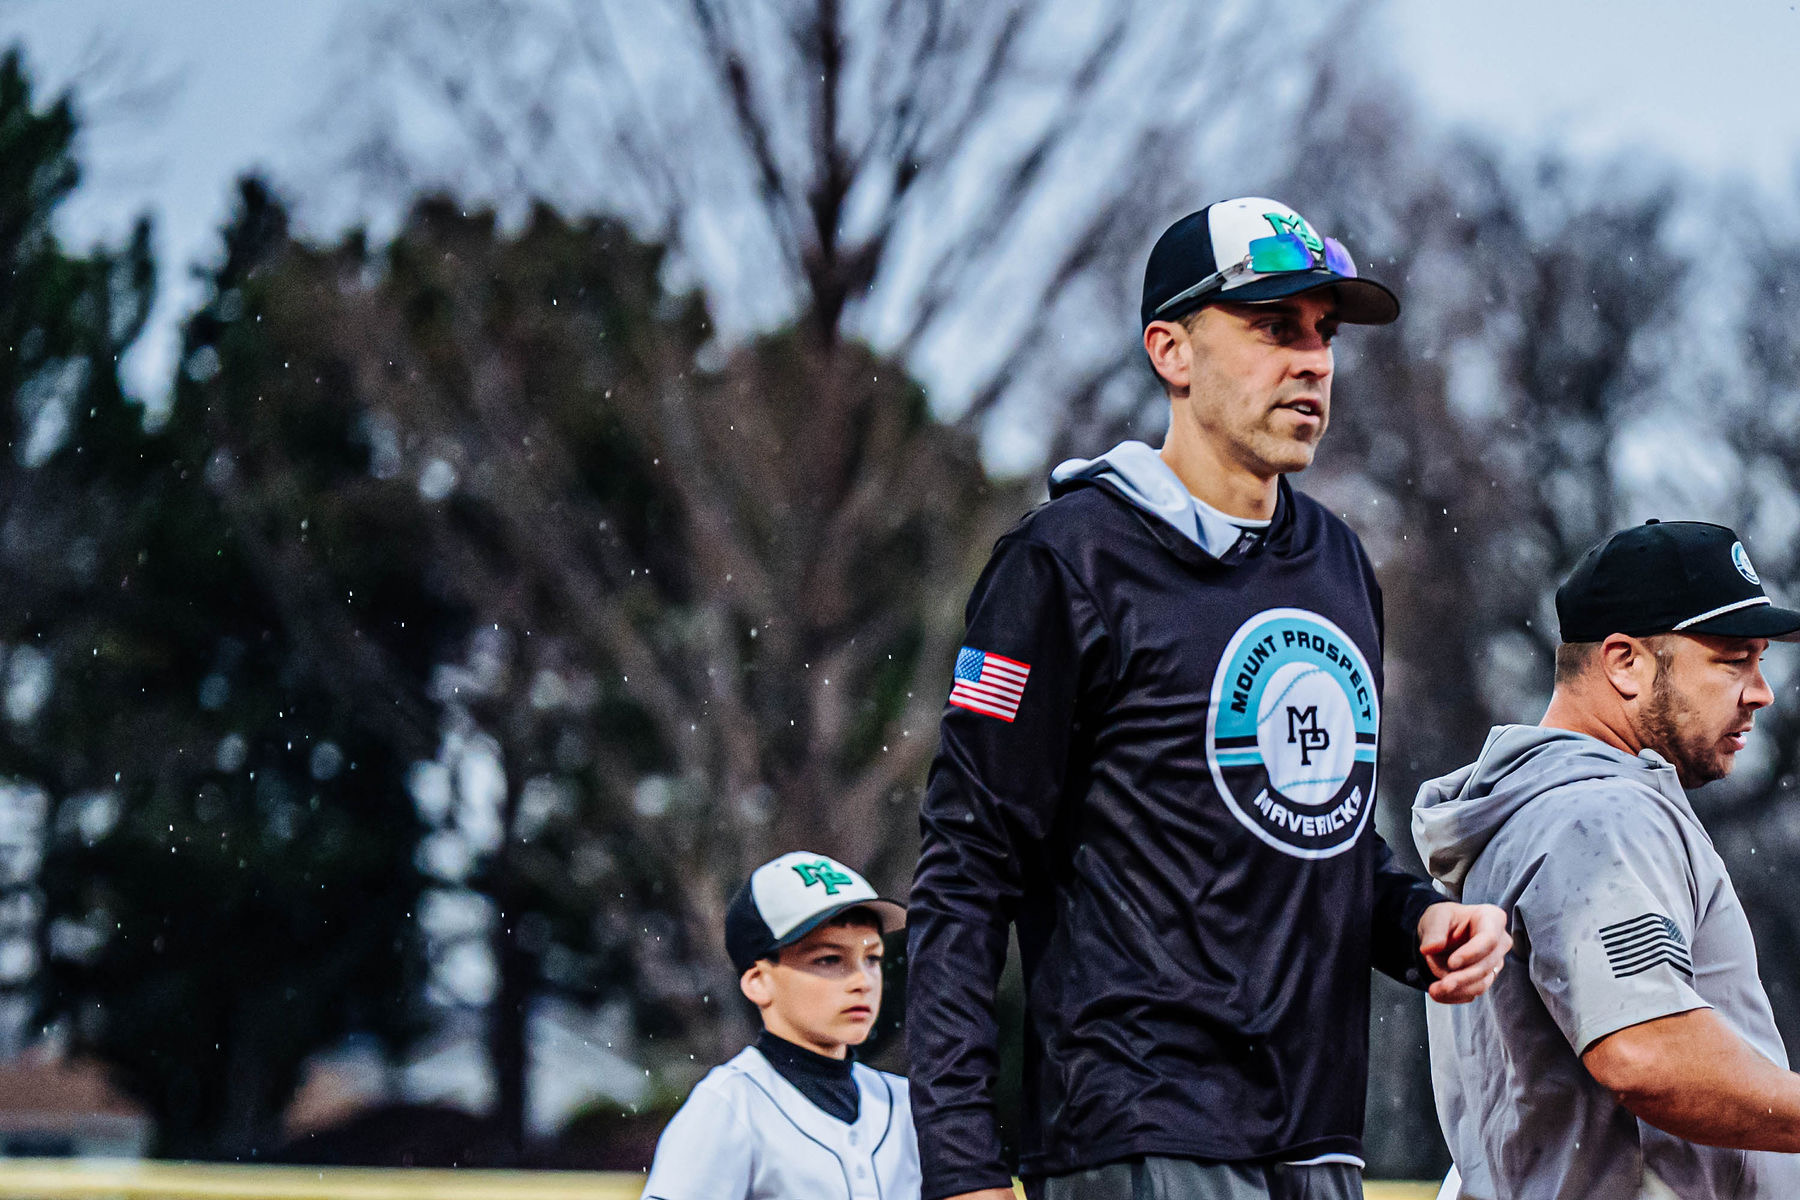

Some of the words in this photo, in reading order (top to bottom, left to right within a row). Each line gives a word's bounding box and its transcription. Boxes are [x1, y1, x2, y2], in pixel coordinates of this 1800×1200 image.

[1231, 634, 1277, 714] MOUNT
[1282, 630, 1372, 721] PROSPECT
[1286, 706, 1330, 766] MP
[1253, 785, 1363, 836] MAVERICKS
